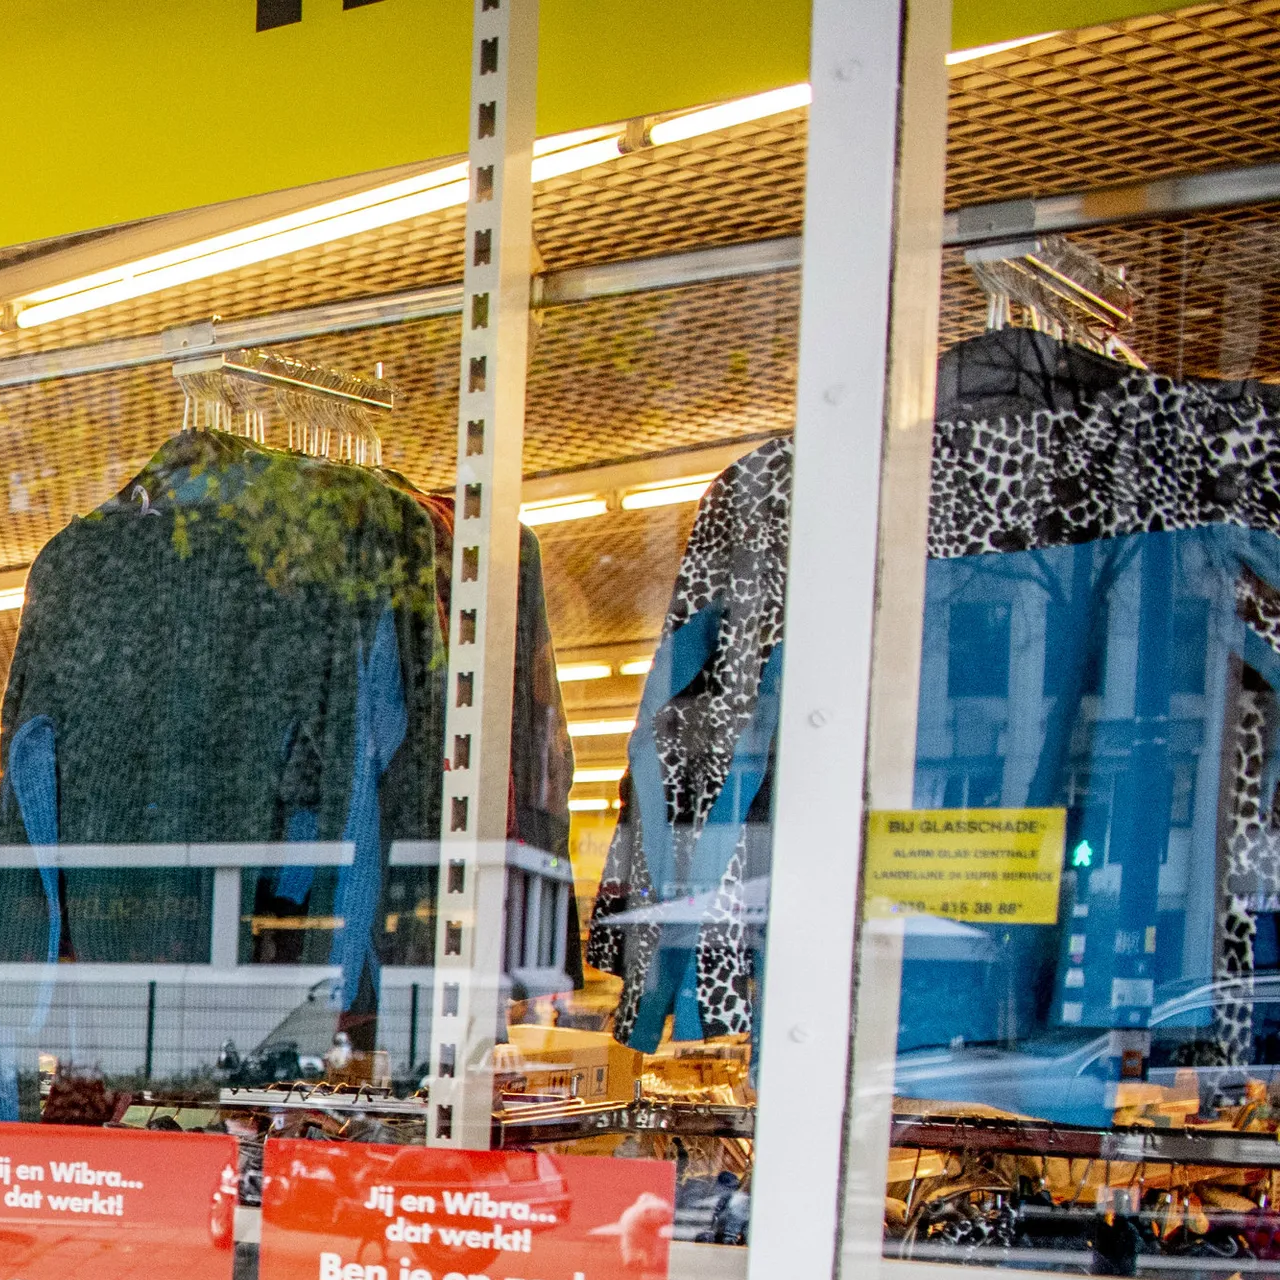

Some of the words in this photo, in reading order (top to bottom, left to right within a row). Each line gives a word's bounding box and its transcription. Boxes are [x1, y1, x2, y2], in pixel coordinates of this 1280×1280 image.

[16, 1164, 44, 1182] en
[49, 1161, 144, 1189] Wibra...
[4, 1185, 43, 1208] dat
[47, 1191, 124, 1216] werkt!
[364, 1185, 394, 1217] Jij
[400, 1193, 435, 1213] en
[442, 1191, 557, 1224] Wibra...
[385, 1217, 433, 1243] dat
[438, 1224, 532, 1253] werkt!
